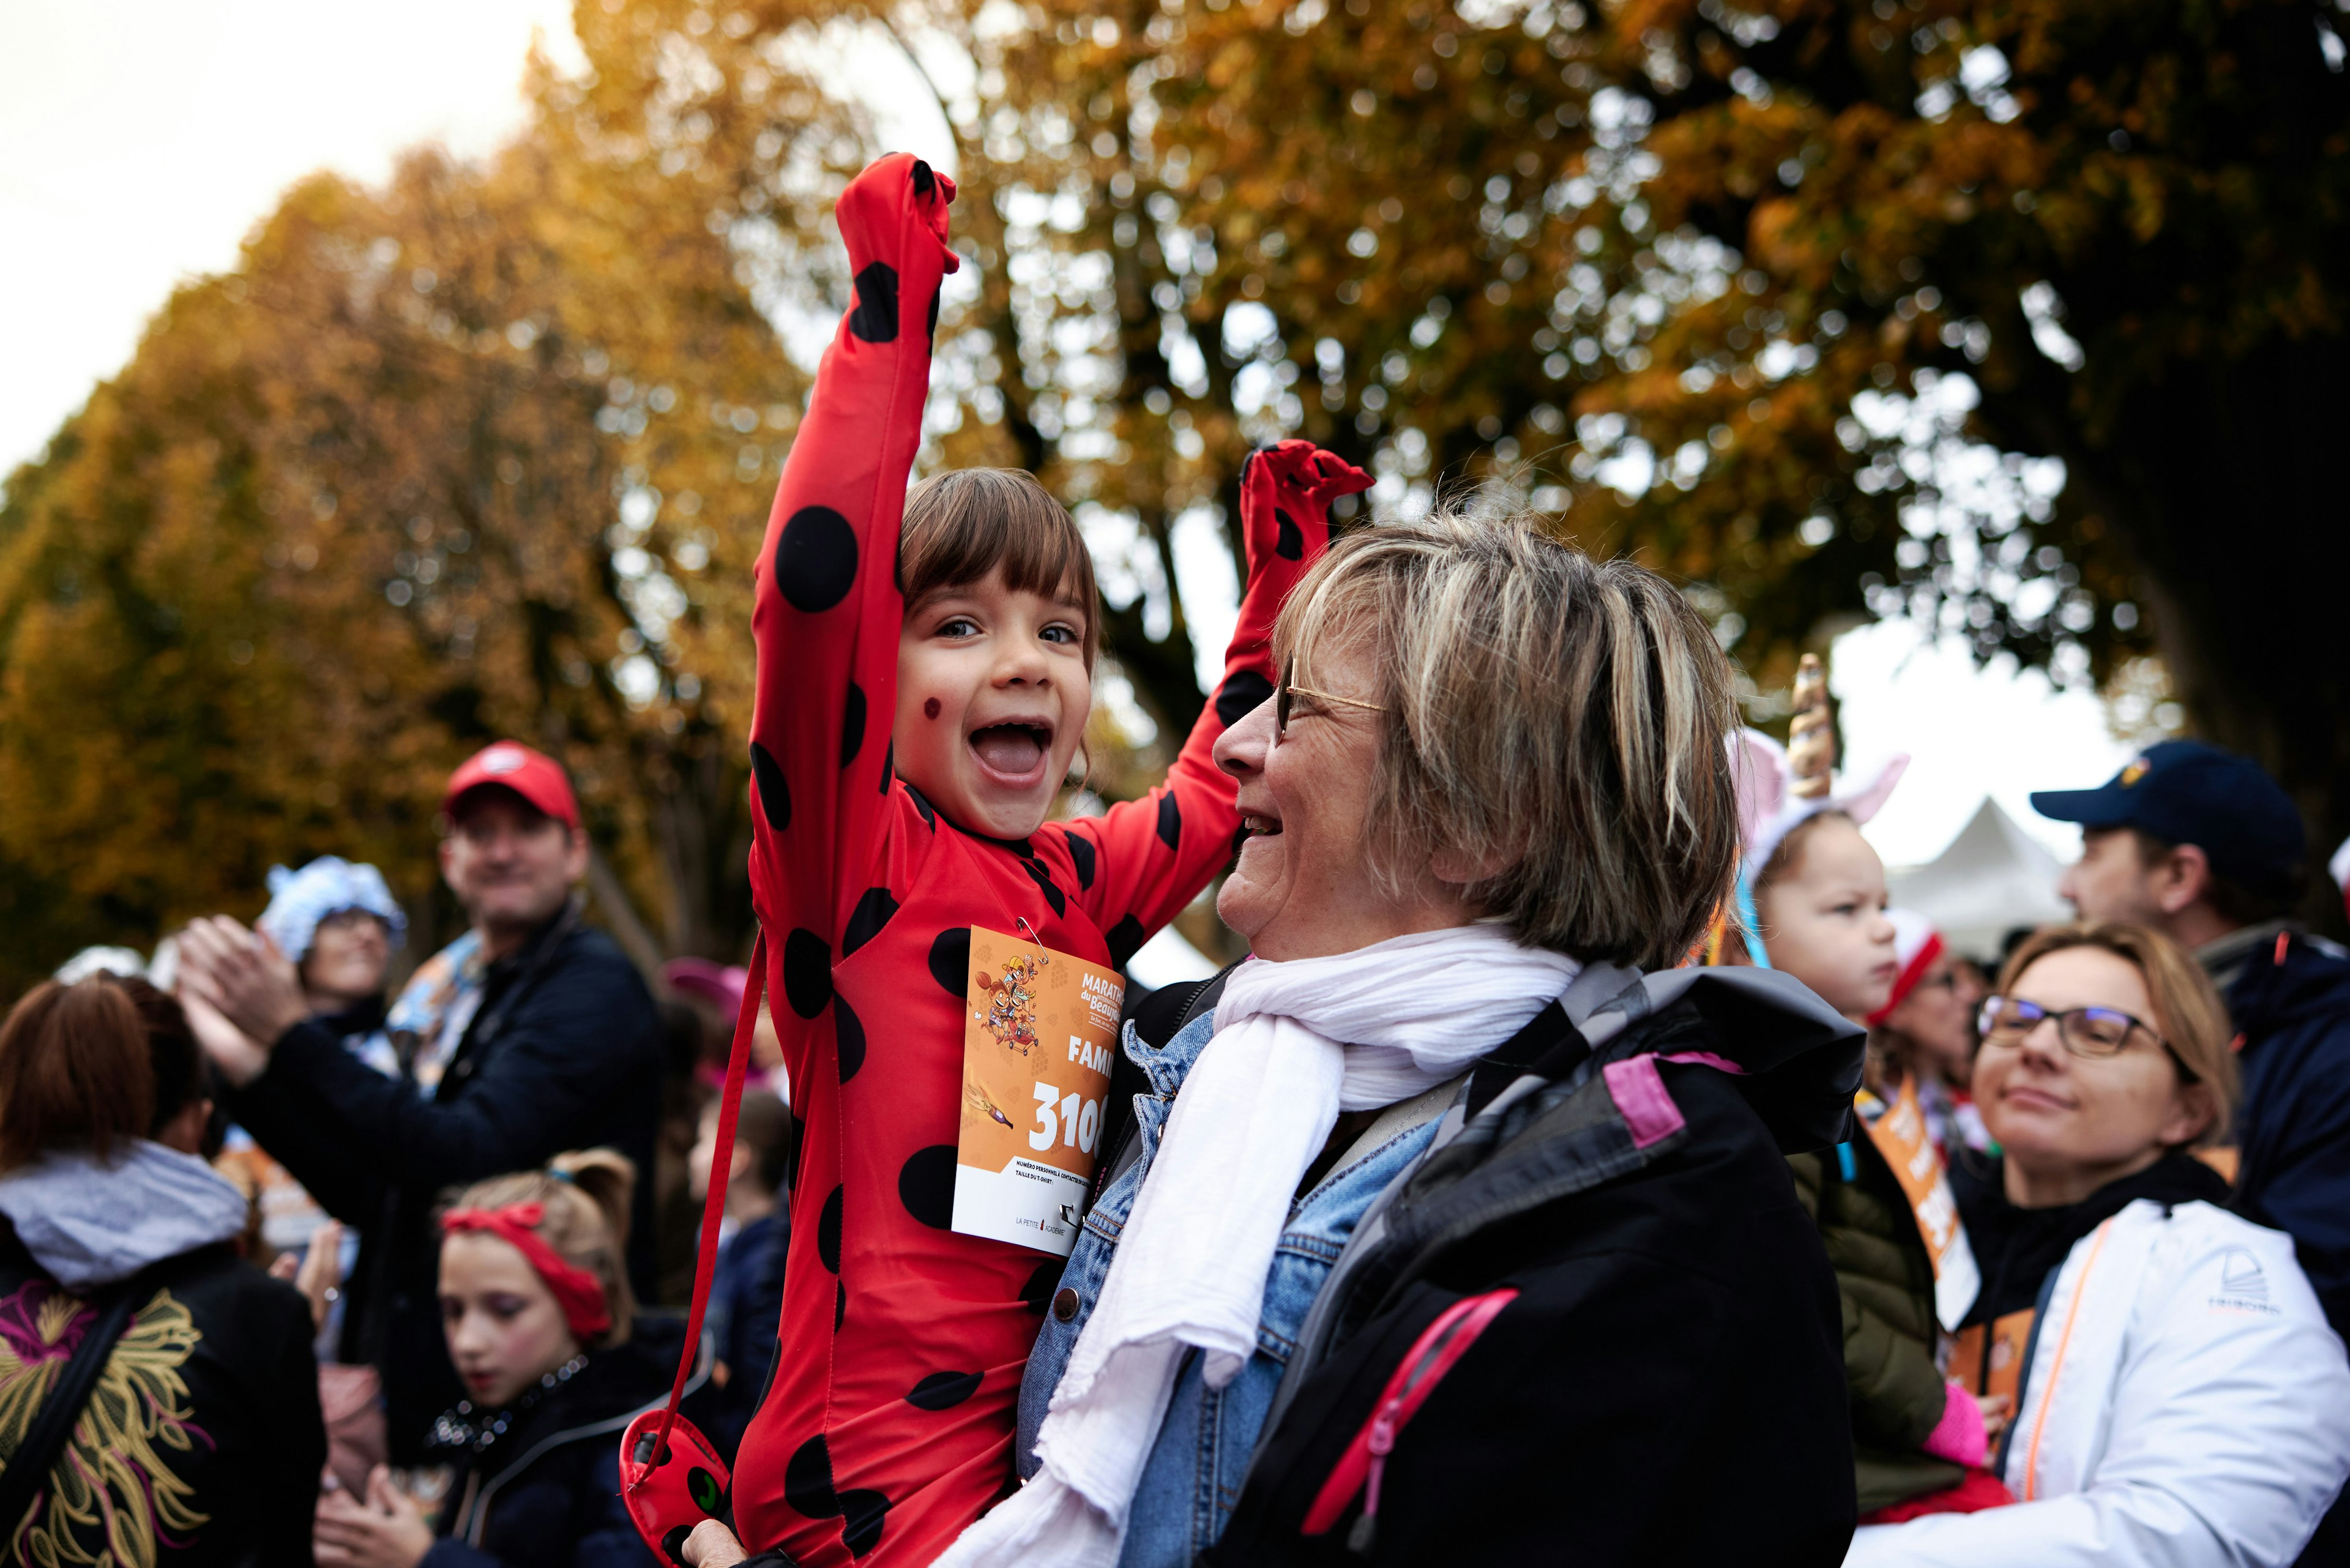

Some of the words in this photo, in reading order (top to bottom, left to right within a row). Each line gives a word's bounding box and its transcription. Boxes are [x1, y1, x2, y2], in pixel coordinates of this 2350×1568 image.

[1081, 989, 1091, 1002] du
[1082, 973, 1125, 1006] MARATHO
[1016, 1160, 1035, 1170] NUMÉRO
[1035, 1165, 1057, 1176] PERSONNEL
[1061, 1173, 1078, 1184] CONTACTER
[1023, 1219, 1039, 1229] PETITE
[1045, 1225, 1065, 1236] ACADEMIE
